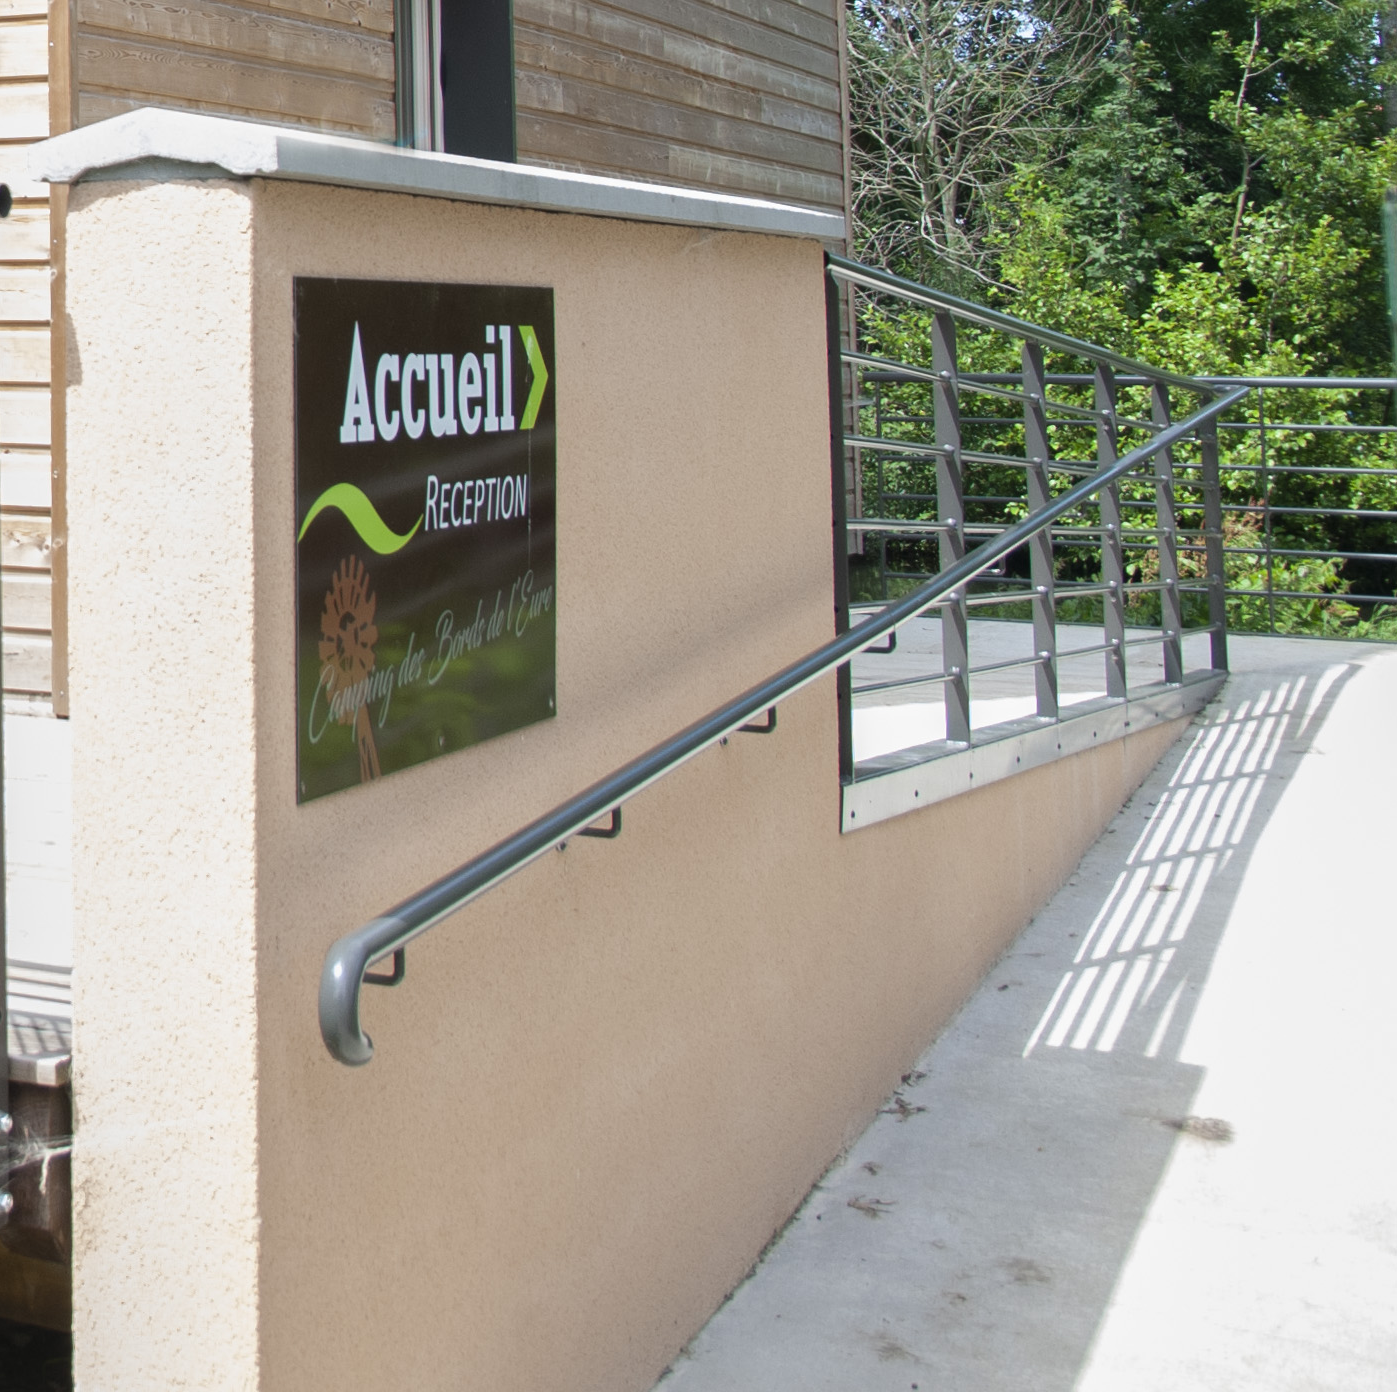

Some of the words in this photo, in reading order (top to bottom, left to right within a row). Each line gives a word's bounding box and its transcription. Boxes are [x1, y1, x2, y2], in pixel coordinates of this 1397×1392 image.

[339, 319, 515, 444] Accueil
[424, 473, 527, 532] RECEPTION
[308, 663, 394, 744] Camping
[397, 631, 425, 688] des
[428, 609, 486, 685] Bords
[486, 589, 504, 642] de
